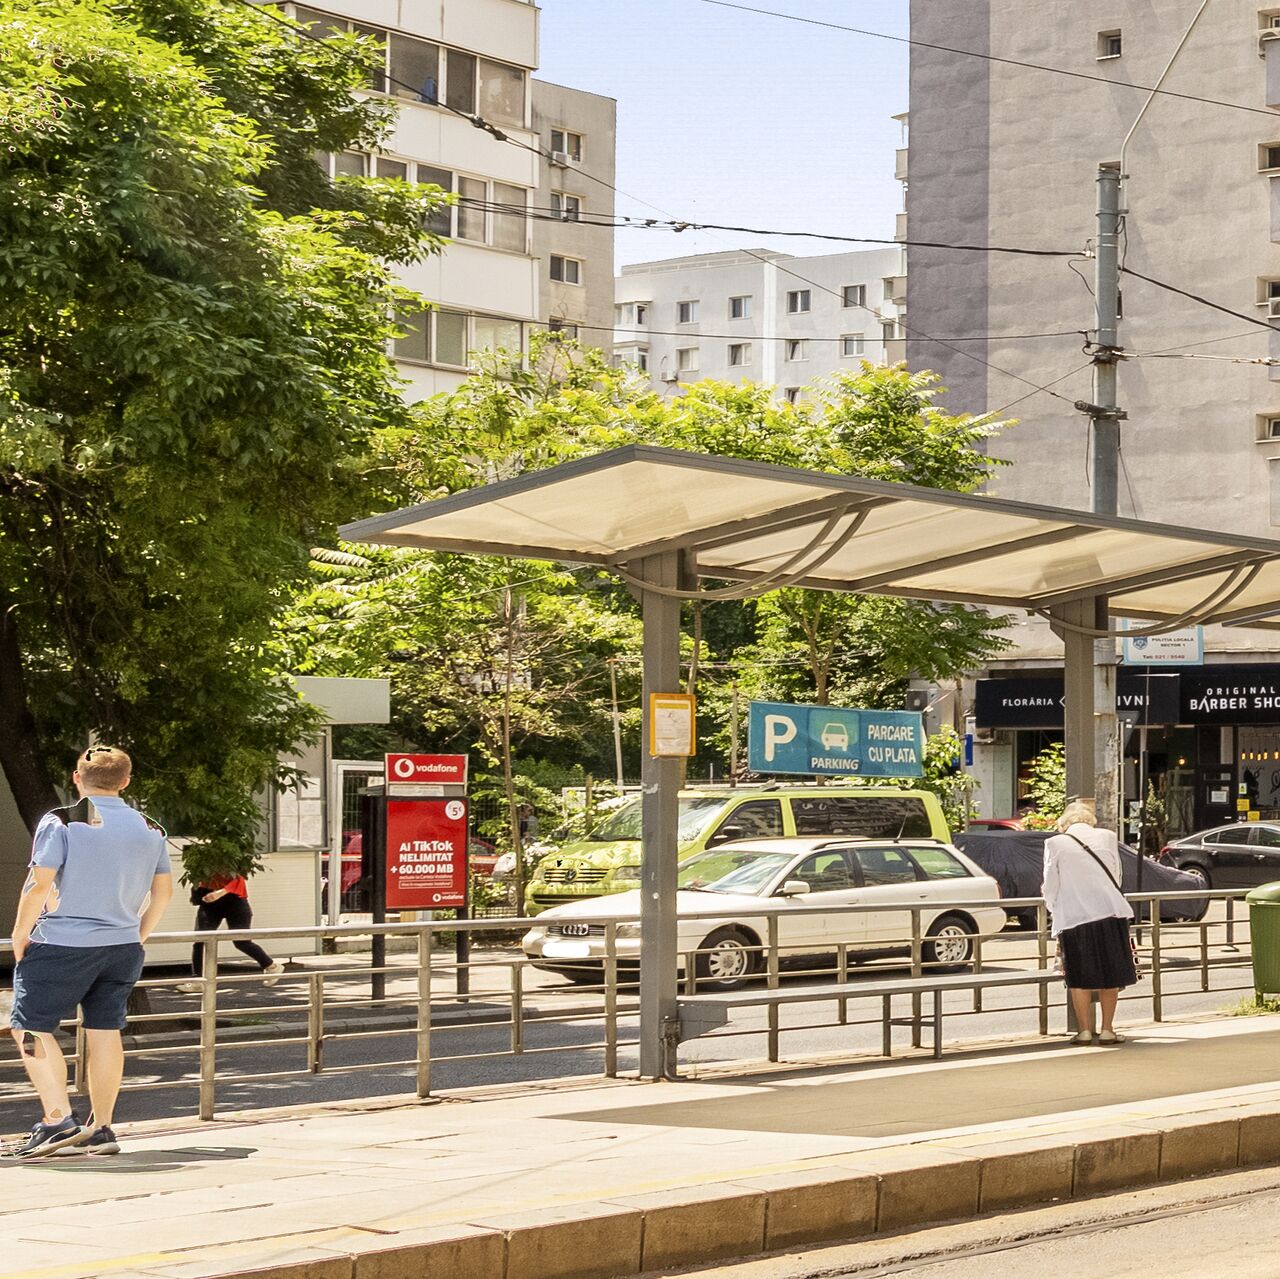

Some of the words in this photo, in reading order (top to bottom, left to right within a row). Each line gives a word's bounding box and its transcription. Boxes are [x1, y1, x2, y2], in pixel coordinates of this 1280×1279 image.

[1206, 686, 1276, 696] ORIGINAL
[764, 714, 797, 762] P
[867, 724, 915, 742] PARCARE
[868, 746, 883, 762] CU
[884, 747, 917, 763] PLATA
[416, 764, 458, 773] vodafone
[811, 757, 860, 770] PARKING
[413, 840, 453, 852] TikTok
[399, 852, 453, 862] NELIMITAT
[399, 864, 436, 874] 60.000
[436, 864, 454, 873] MB
